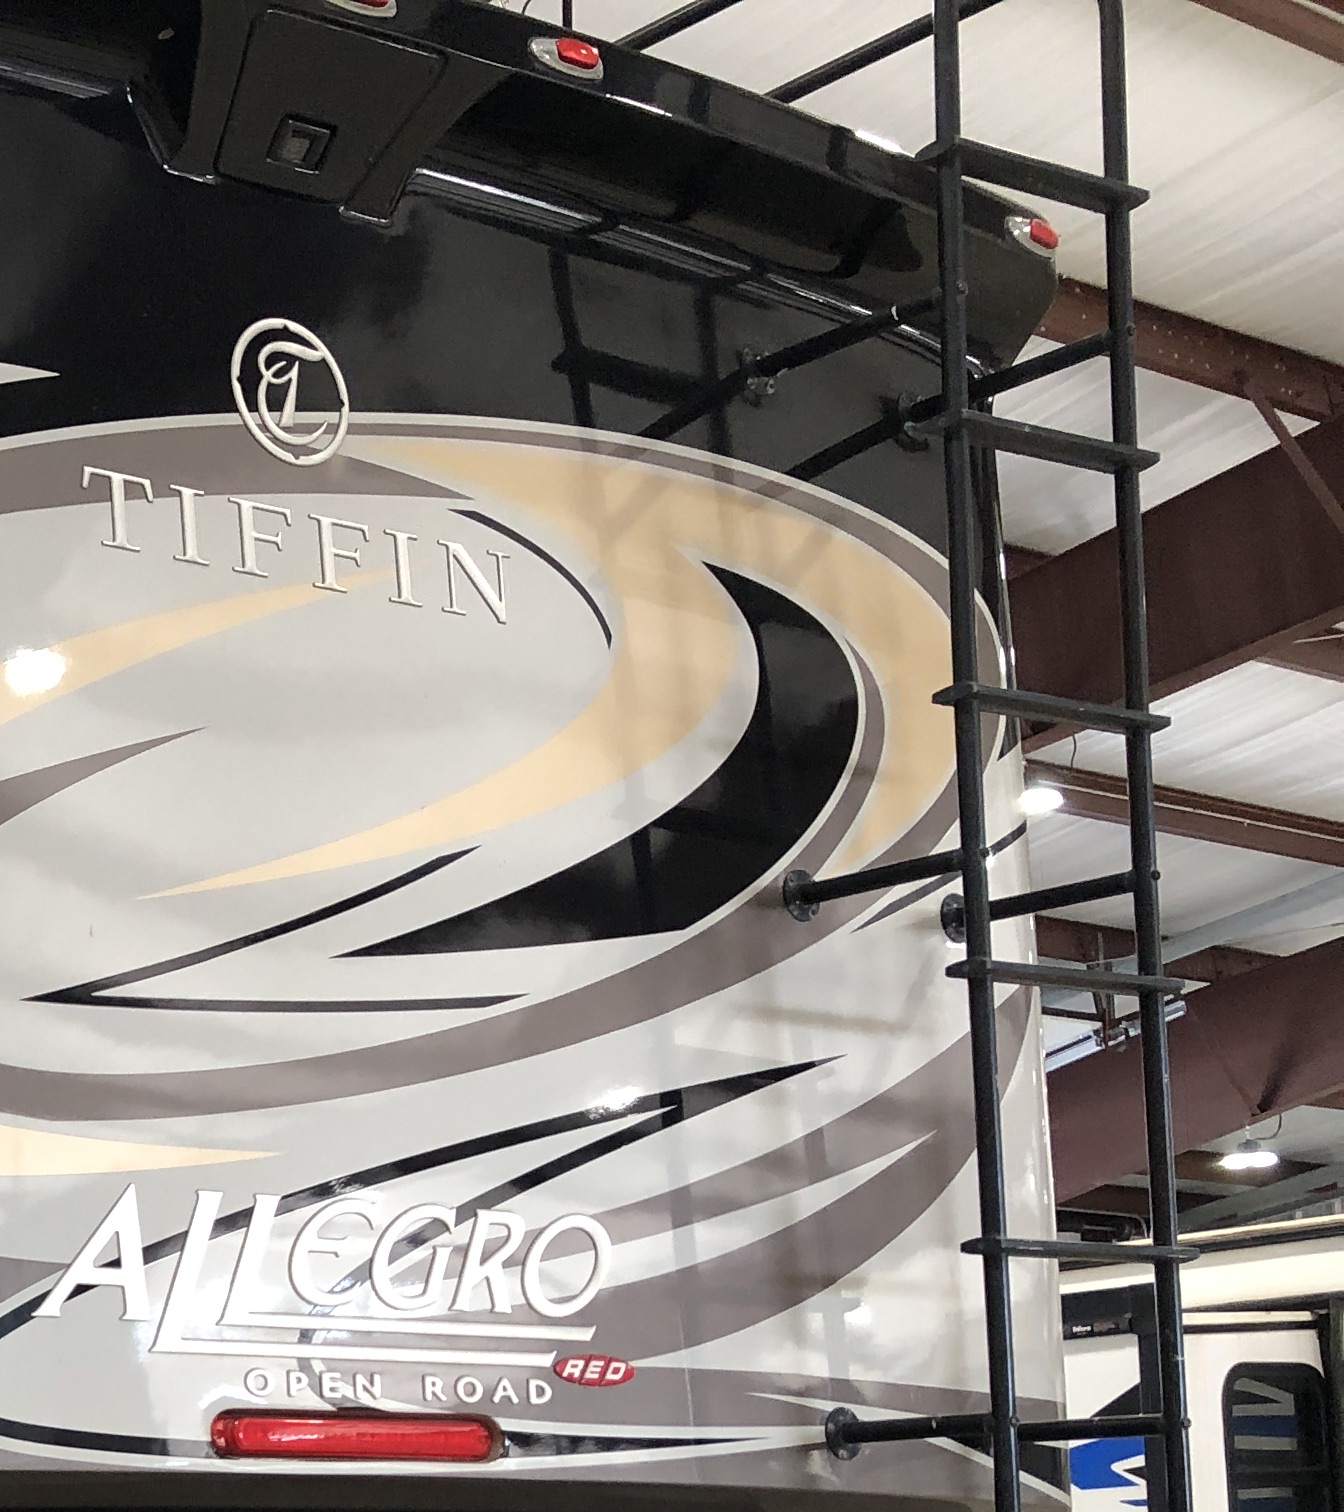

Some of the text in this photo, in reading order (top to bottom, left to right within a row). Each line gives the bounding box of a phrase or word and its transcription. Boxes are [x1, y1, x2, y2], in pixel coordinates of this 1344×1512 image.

[81, 464, 512, 625] TIFFIN
[30, 1182, 615, 1366] ALLEGRO
[243, 1366, 555, 1406] OPEN ROAD
[562, 1357, 628, 1383] RED
